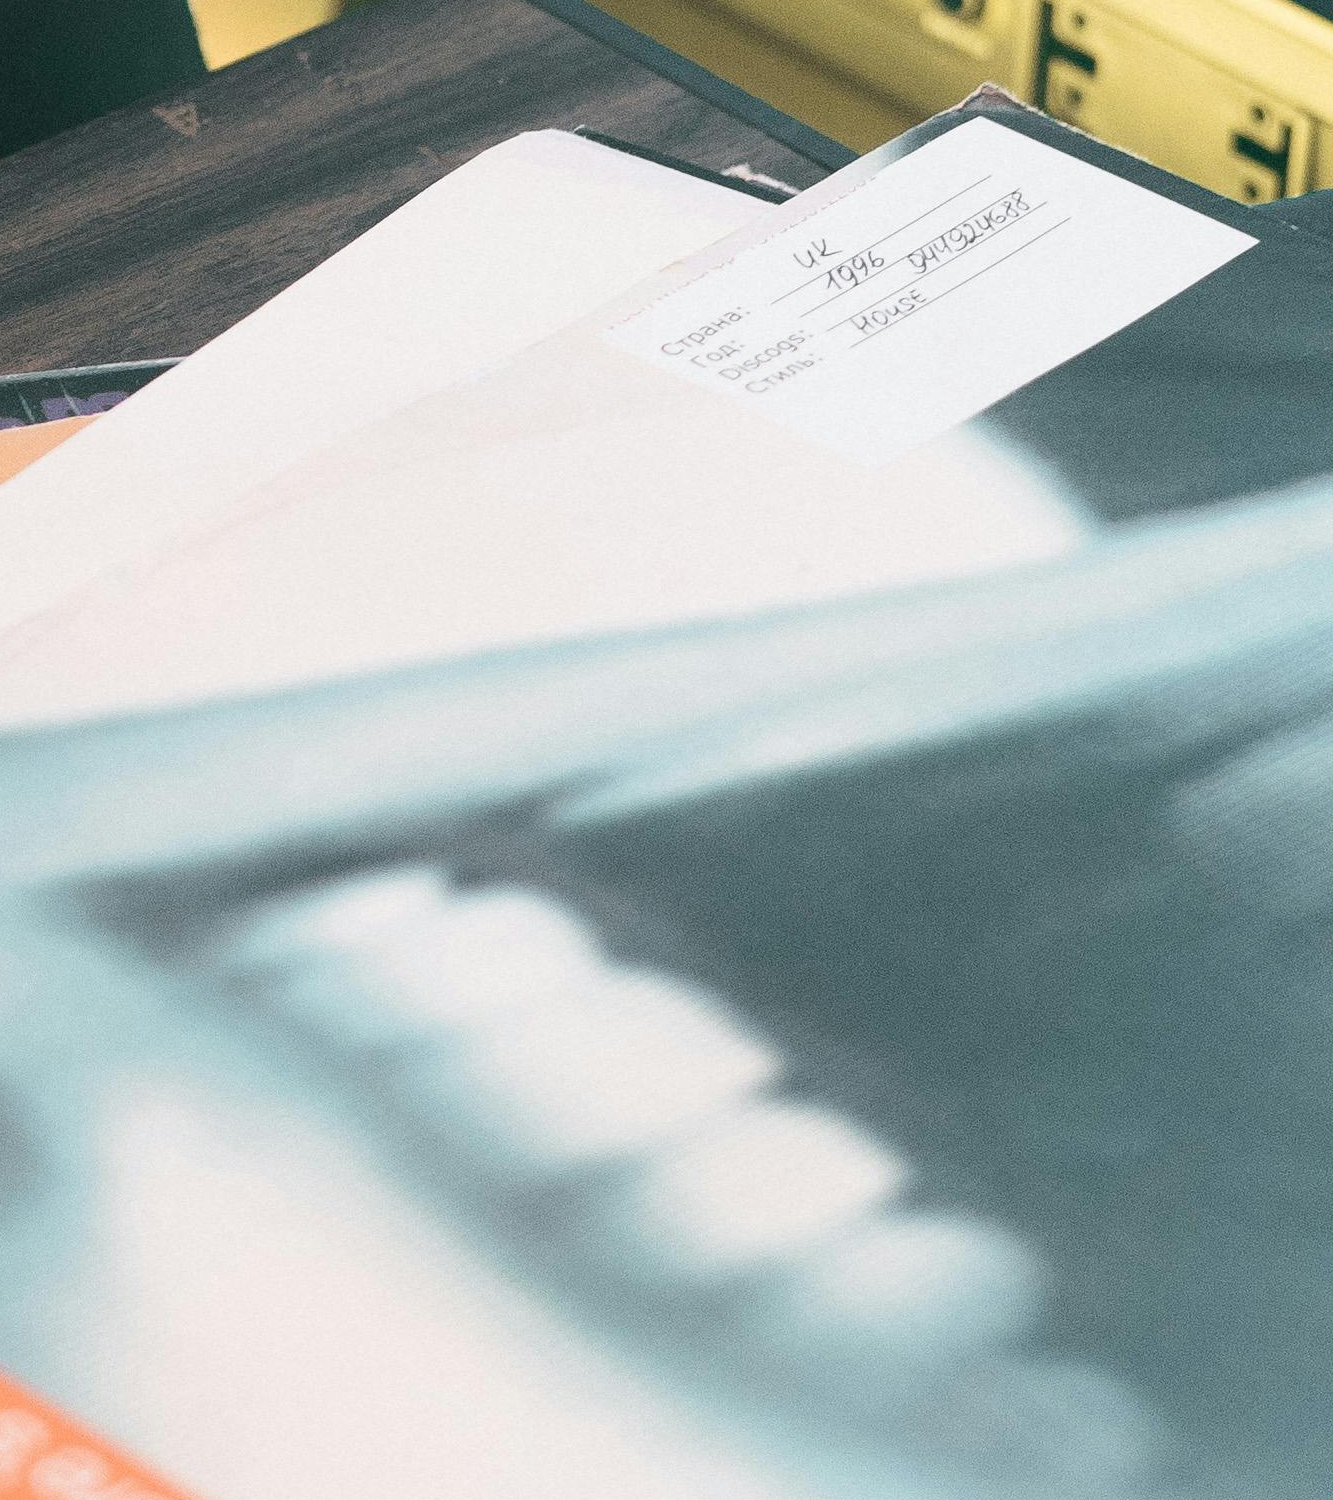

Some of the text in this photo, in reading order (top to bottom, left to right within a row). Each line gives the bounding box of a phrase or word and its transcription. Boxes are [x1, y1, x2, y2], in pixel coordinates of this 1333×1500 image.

[826, 251, 885, 291] 1996
[660, 306, 751, 358] Страна:
[690, 339, 746, 369] Год:
[718, 329, 815, 382] Discogs:
[744, 352, 825, 396] Стиль:
